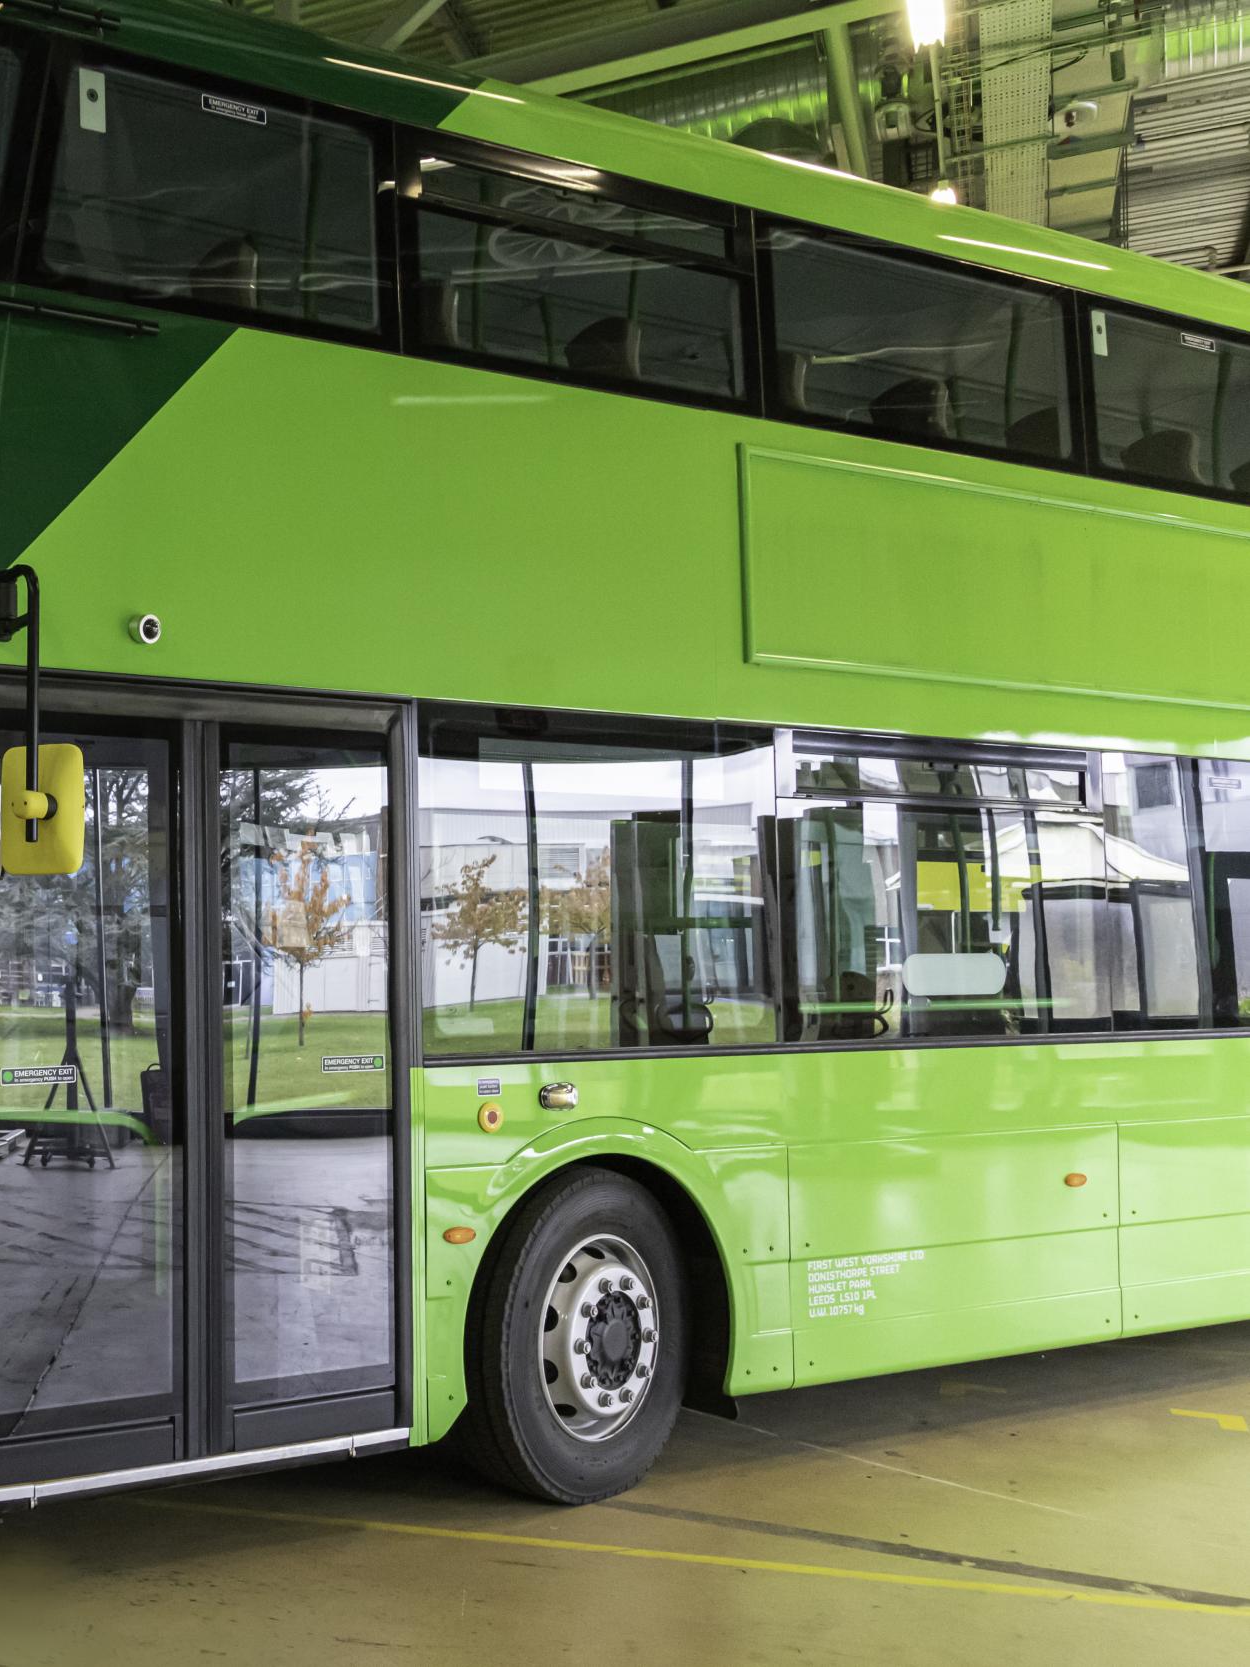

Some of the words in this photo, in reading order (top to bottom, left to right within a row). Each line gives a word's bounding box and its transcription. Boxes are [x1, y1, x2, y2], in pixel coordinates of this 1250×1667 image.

[208, 98, 245, 113] EMERGENCY
[324, 1058, 360, 1066] EMERGENCY
[14, 1069, 56, 1077] EMERGENCY
[808, 1259, 831, 1271] FIRST
[835, 1257, 858, 1268] WEST
[861, 1252, 907, 1265] YORKSHIRE
[808, 1267, 867, 1282] DONISTHORPE
[870, 1264, 900, 1276] STREET
[809, 1281, 847, 1294] HUNSLET
[849, 1279, 871, 1288] PARK
[809, 1294, 835, 1306] LEEDS
